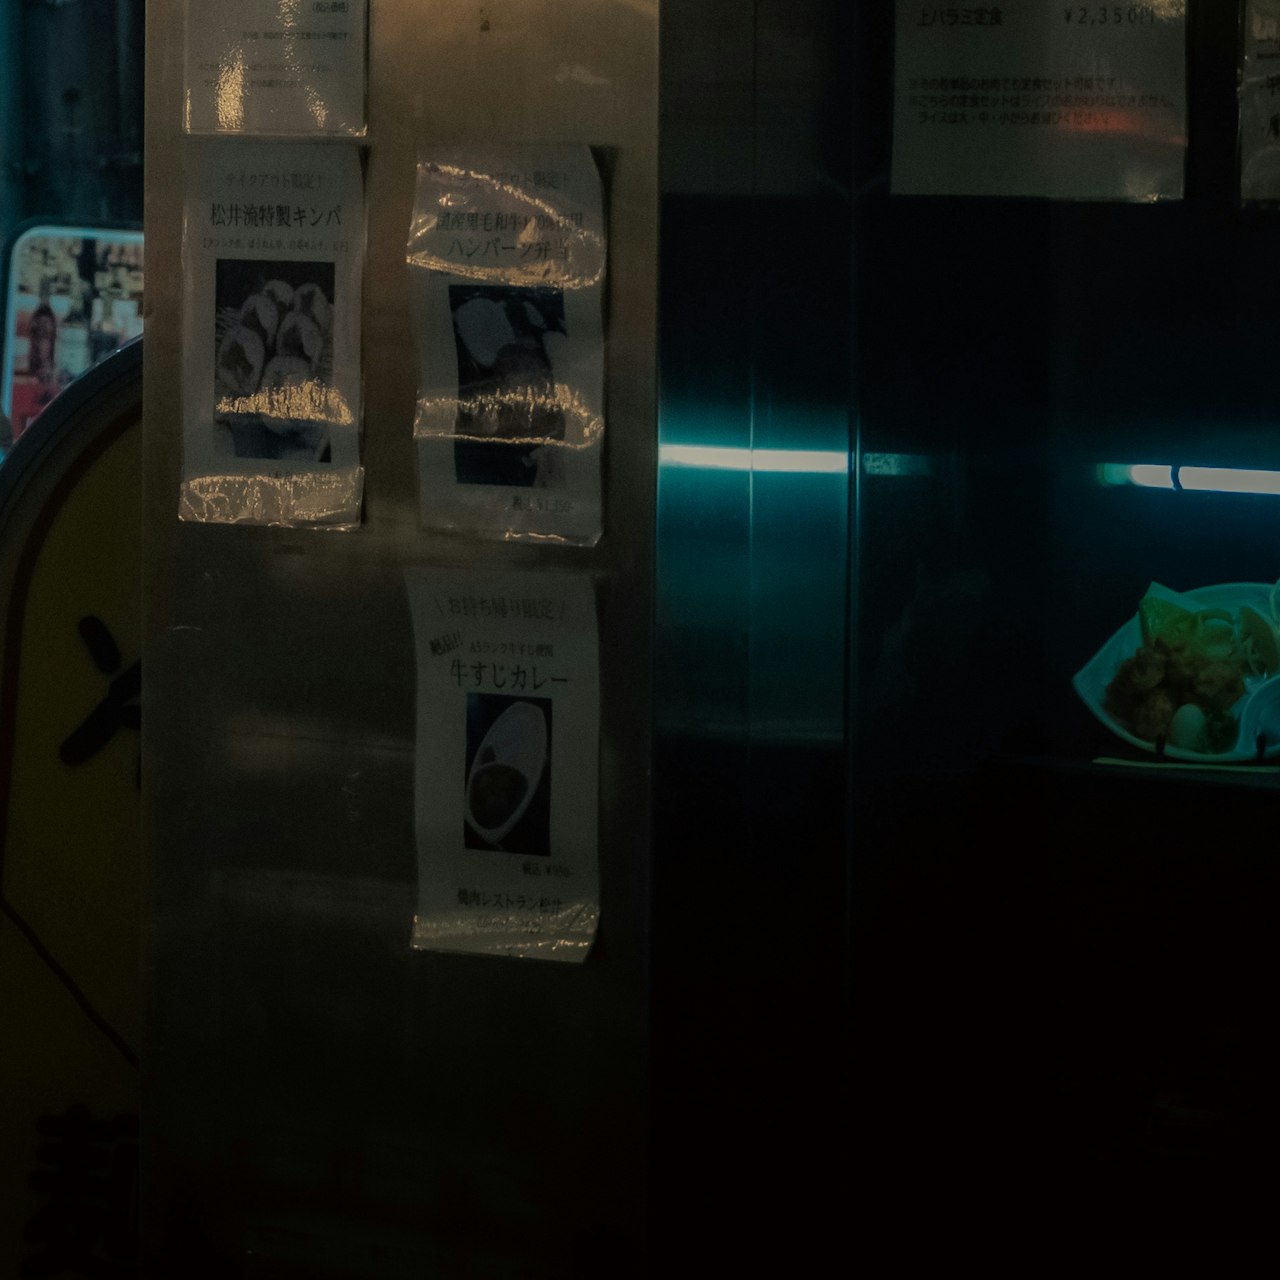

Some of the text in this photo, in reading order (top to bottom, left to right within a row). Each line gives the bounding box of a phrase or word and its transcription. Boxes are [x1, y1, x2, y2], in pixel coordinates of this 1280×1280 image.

[917, 7, 1002, 27] 上ハラミ定食
[210, 203, 342, 228] 松井流特製キンパ
[450, 660, 568, 690] 牛すじカレー
[457, 886, 562, 914] 焼肉レストラン松井
